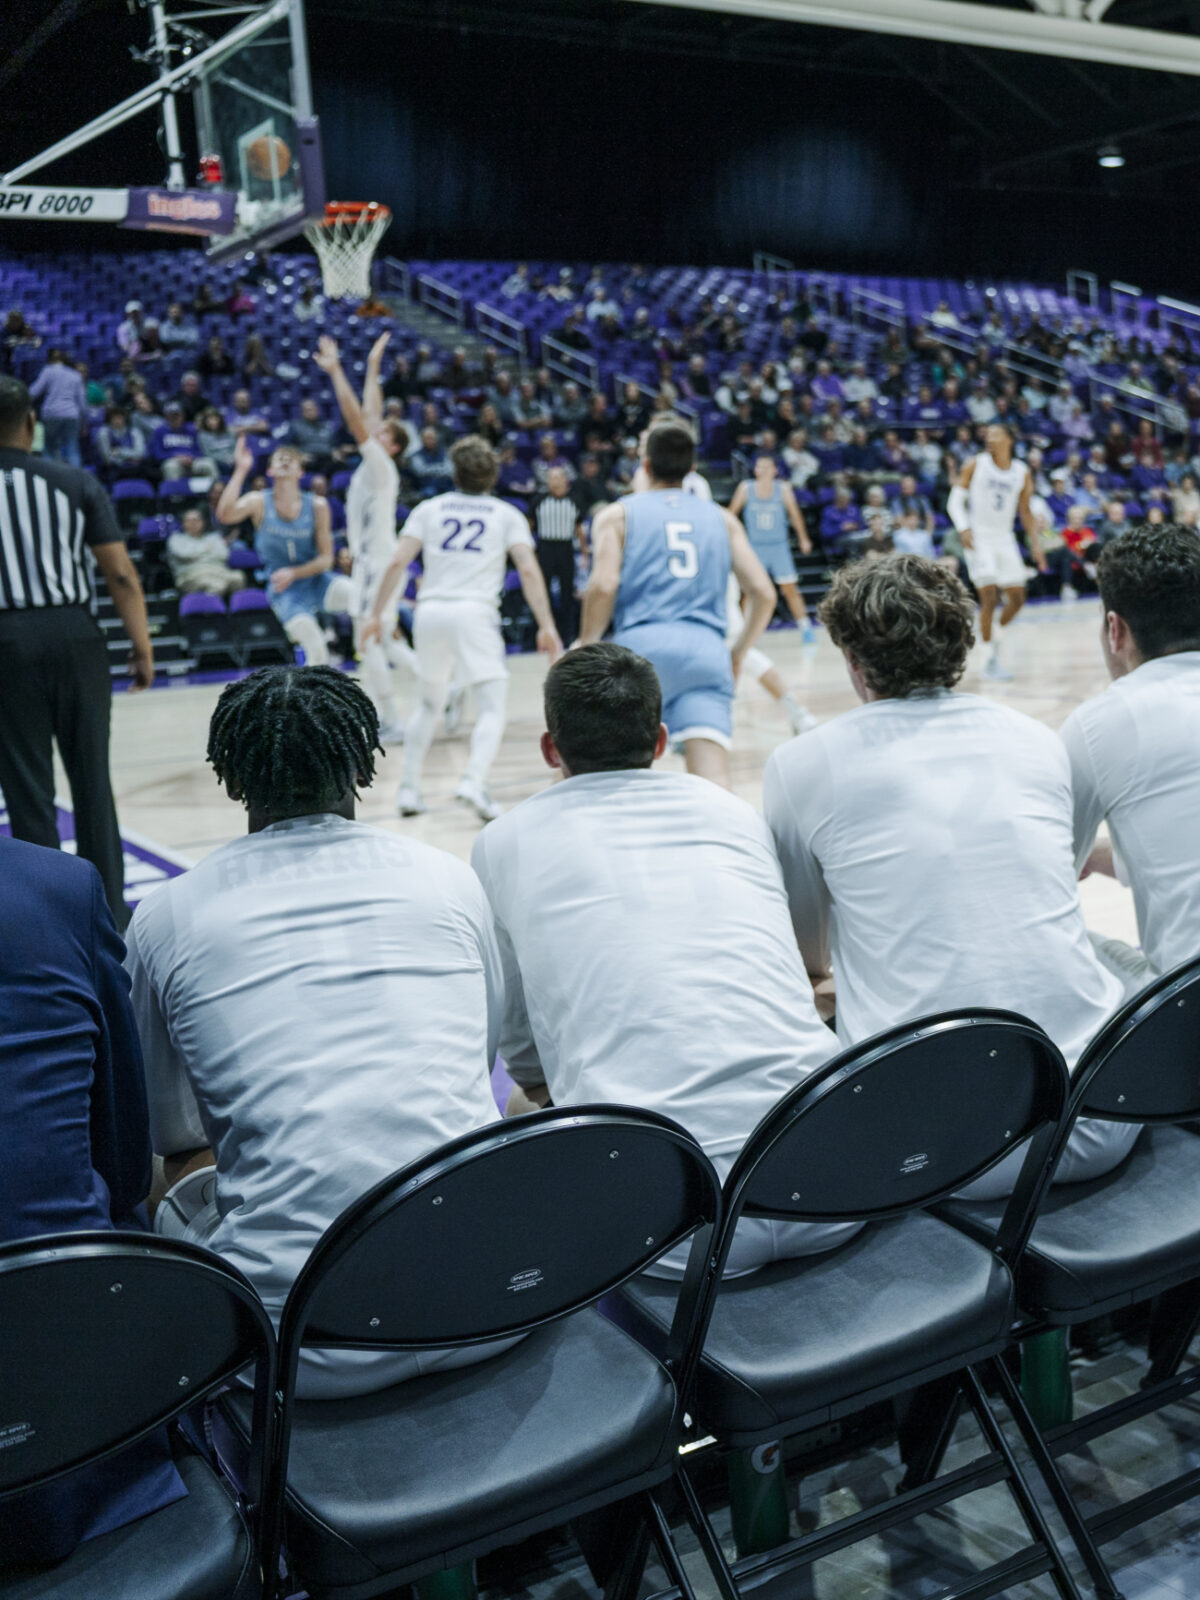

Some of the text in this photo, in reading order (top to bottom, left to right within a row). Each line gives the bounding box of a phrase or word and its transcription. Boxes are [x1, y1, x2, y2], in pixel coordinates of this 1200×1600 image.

[38, 194, 93, 214] 8000
[441, 518, 485, 552] 22
[665, 521, 698, 578] 5
